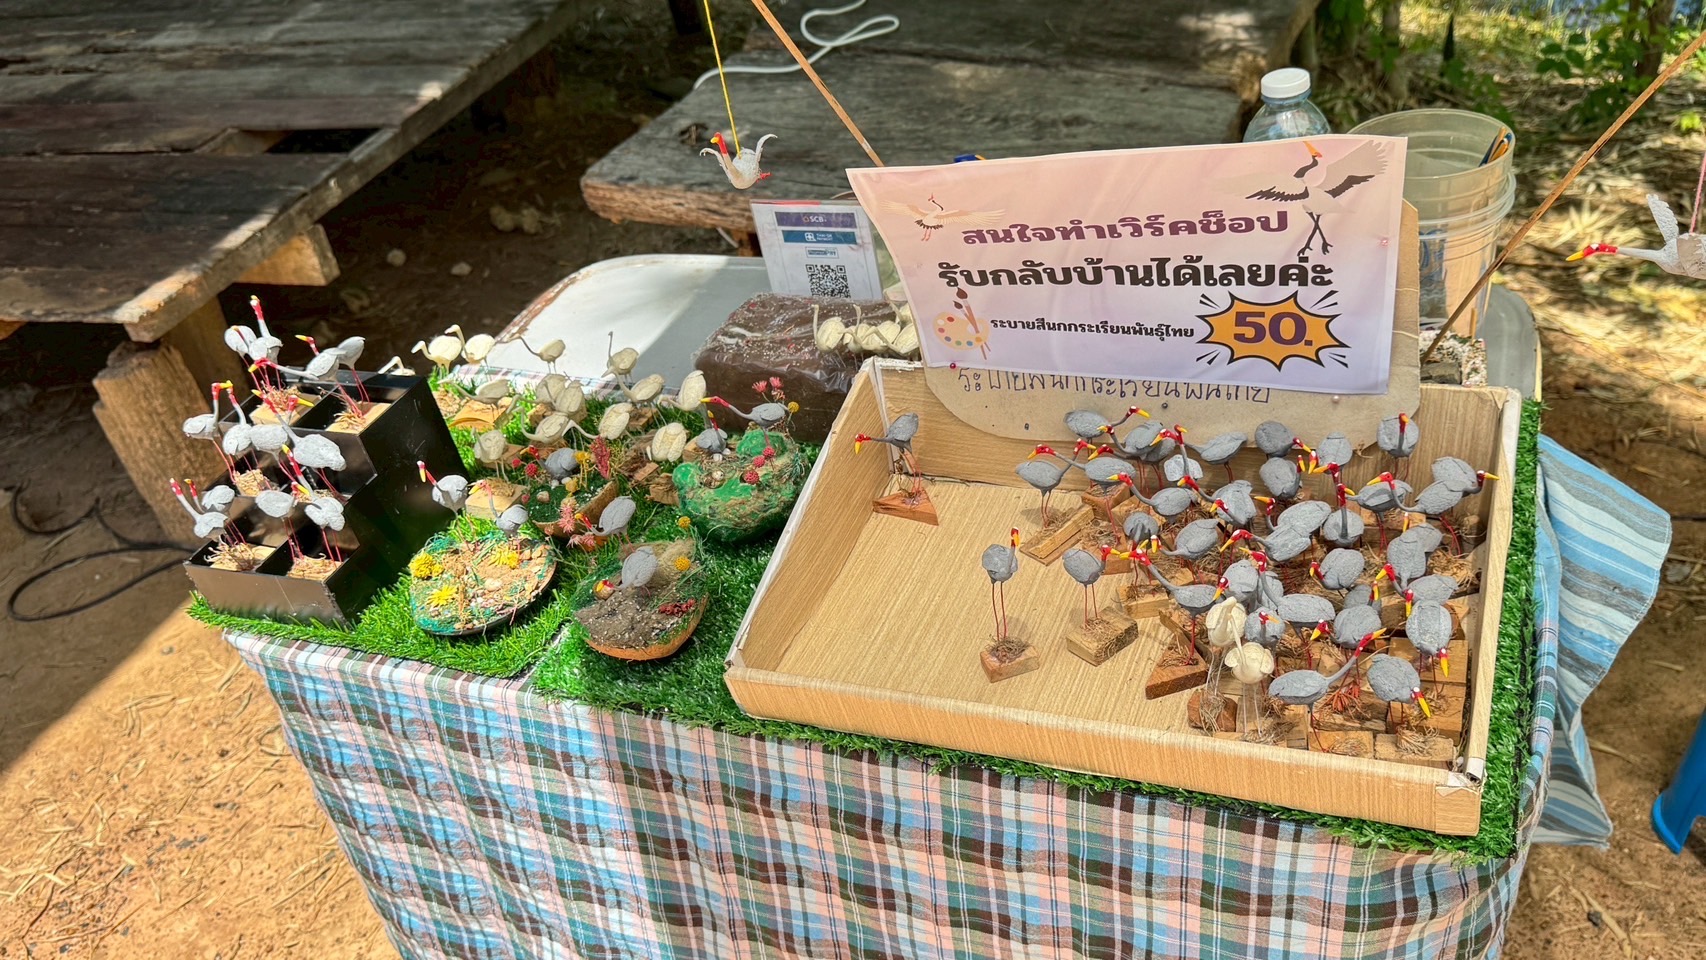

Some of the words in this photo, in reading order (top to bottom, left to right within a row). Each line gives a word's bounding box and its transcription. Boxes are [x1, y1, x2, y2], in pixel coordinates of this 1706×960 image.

[961, 210, 1288, 244] สนใจทำเวิร์คช็อป
[938, 255, 1333, 288] รับกลับบ้านได้เลยค่ะ
[990, 318, 1194, 341] ระบายสีนกกระเรียนพันธุ์ไทย
[1233, 311, 1313, 346] 50.
